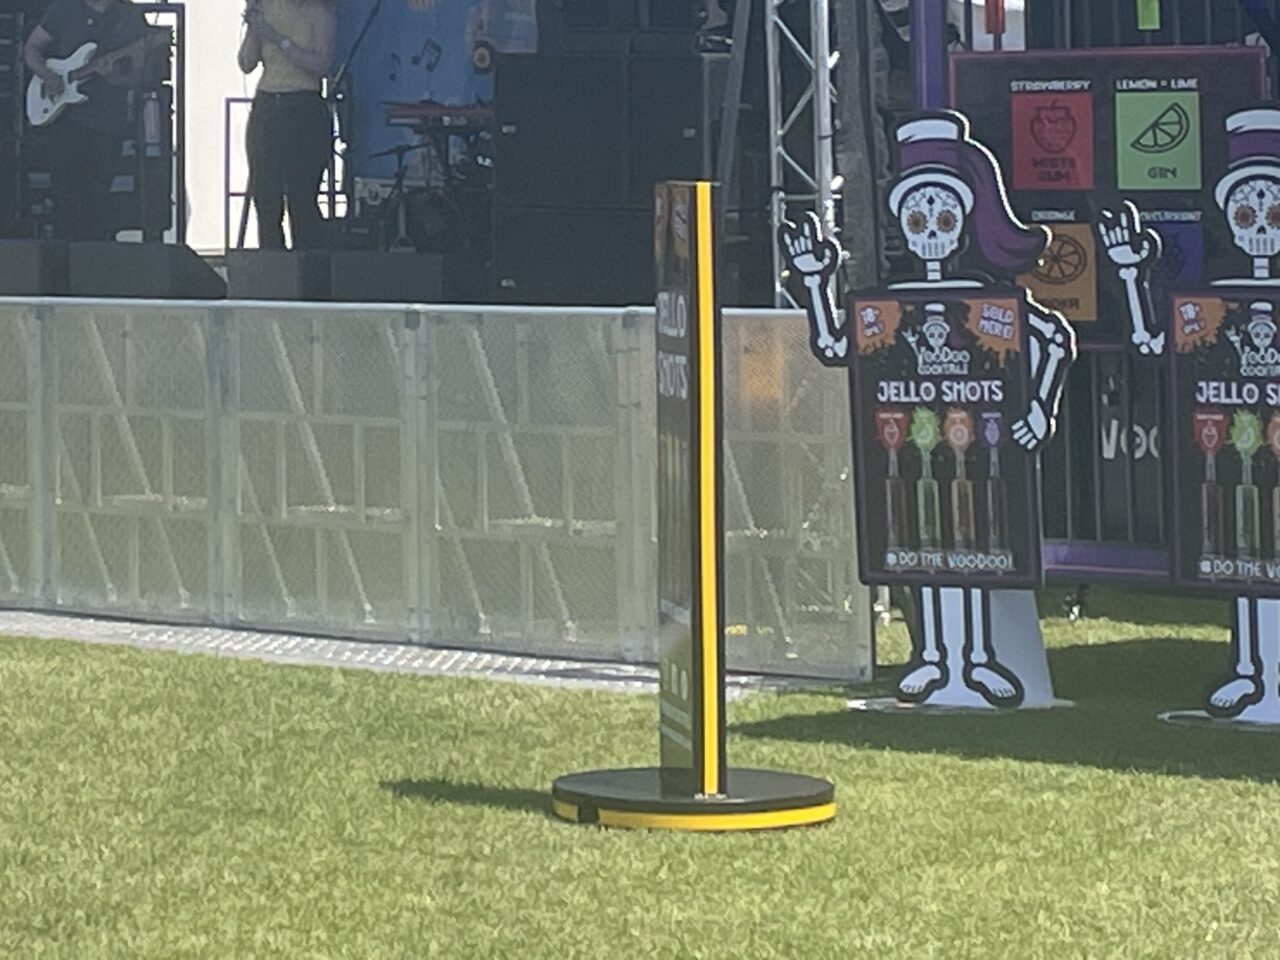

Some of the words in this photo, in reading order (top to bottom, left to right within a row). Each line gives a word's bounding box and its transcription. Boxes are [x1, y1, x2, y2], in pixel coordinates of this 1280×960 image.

[1115, 78, 1158, 90] LEMON
[1170, 77, 1199, 89] LIME
[1146, 165, 1178, 179] GIN
[877, 381, 936, 402] JELLO
[941, 380, 1004, 402] SHOTS
[1195, 381, 1259, 404] JELLO
[920, 551, 943, 567] THE
[1236, 560, 1262, 577] THE
